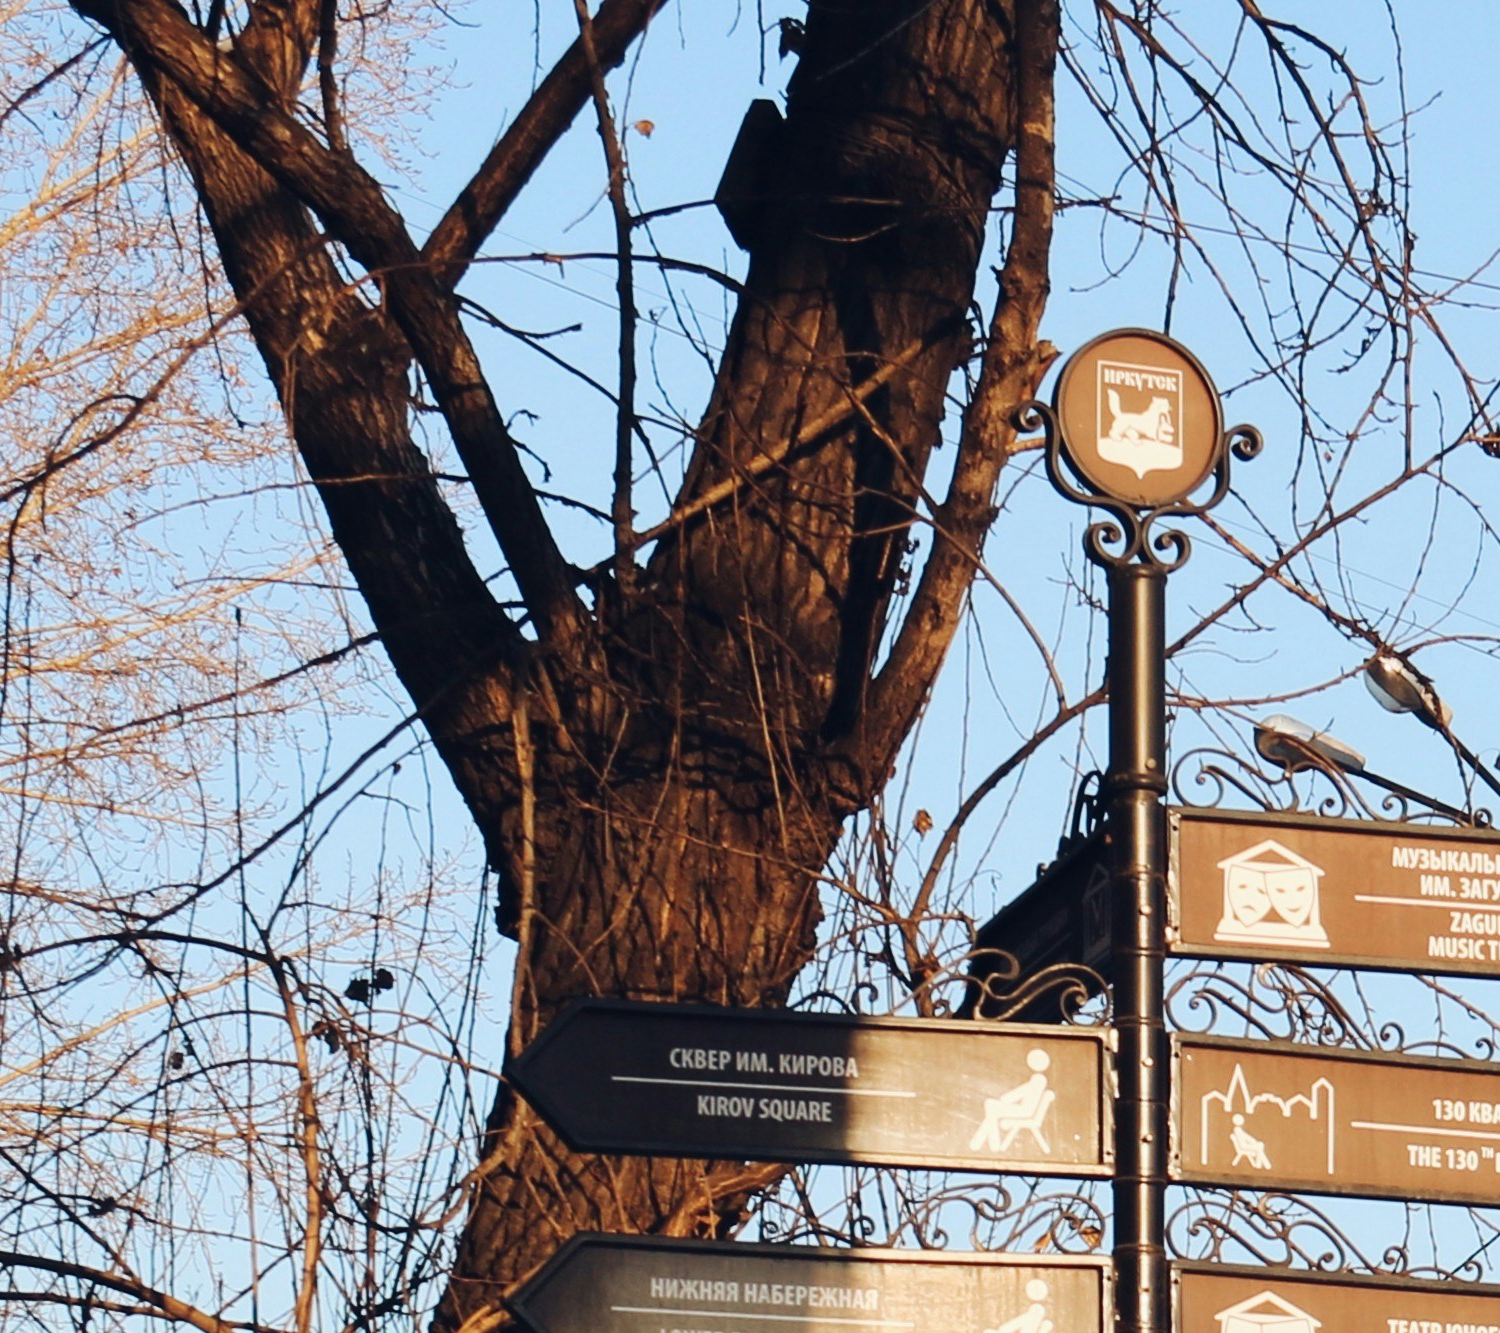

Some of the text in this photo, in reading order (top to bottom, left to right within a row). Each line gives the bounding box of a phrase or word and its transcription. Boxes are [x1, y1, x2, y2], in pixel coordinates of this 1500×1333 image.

[1103, 367, 1177, 392] ИРКУТСК
[1419, 875, 1456, 898] ИМ.
[1427, 936, 1487, 961] MUSIC
[669, 1047, 860, 1079] СКВЕР ИМ. КИРОВА
[697, 1095, 833, 1122] KIROV SQUARE
[1432, 1099, 1465, 1122] 130
[1407, 1144, 1442, 1168] THE
[650, 1277, 879, 1311] НИЖНЯЯ НАБЕРЕЖНАЯ
